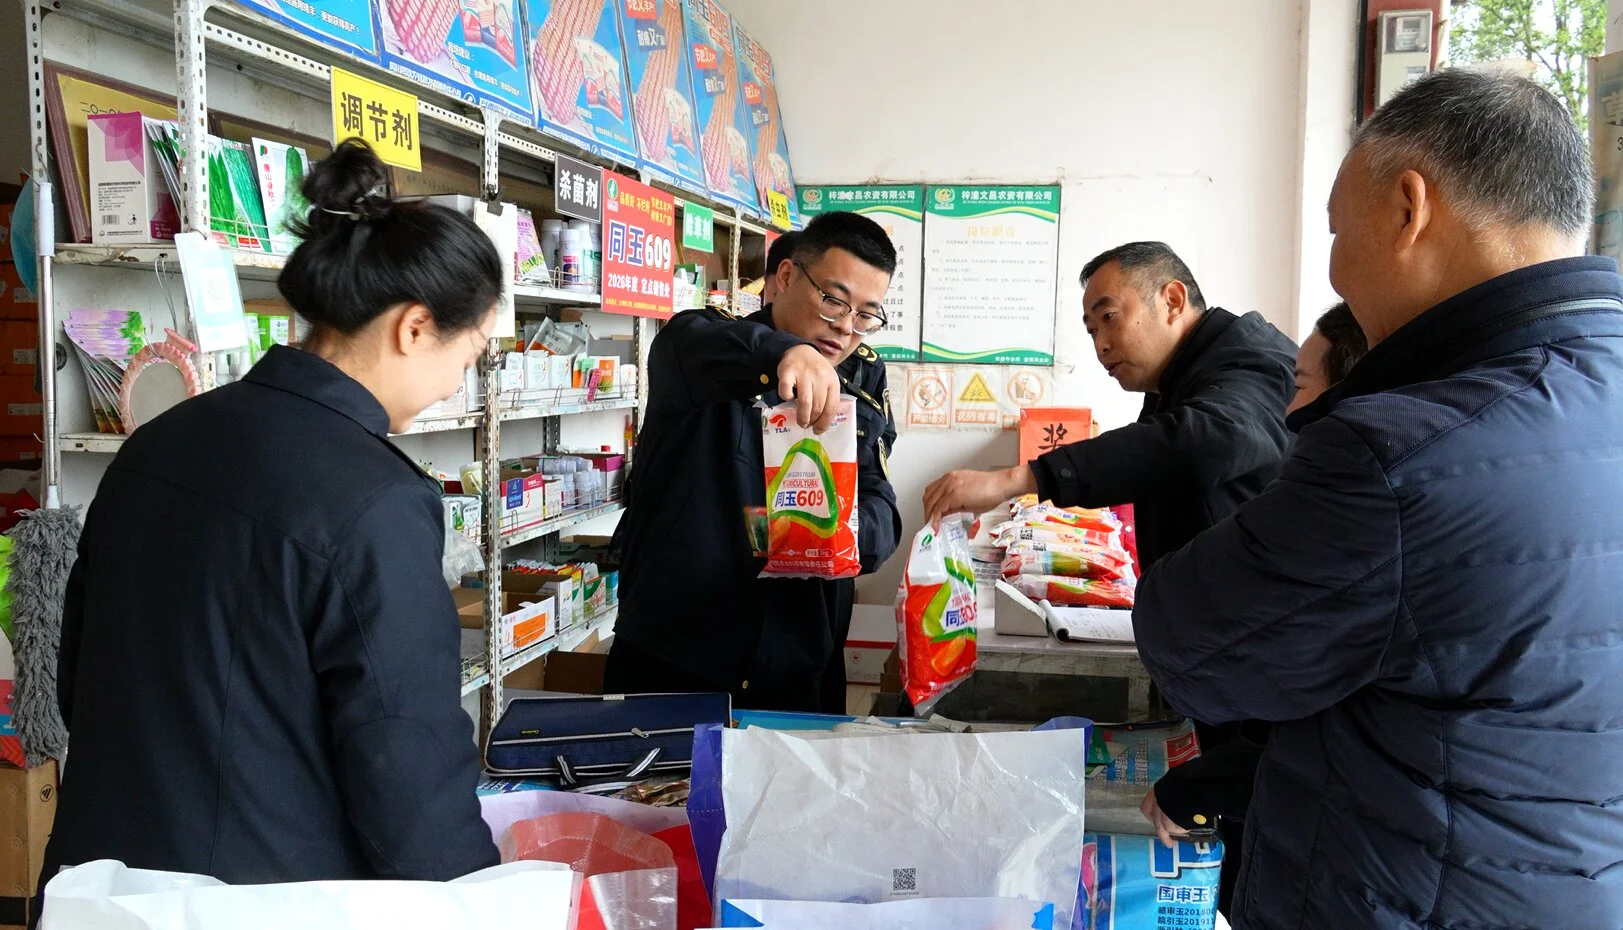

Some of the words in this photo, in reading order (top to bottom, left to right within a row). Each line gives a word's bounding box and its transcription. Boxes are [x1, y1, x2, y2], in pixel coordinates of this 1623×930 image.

[340, 91, 412, 151] 调节剂
[559, 169, 598, 210] 杀菌剂
[961, 190, 1052, 201] 梓潼文昌农资有限公司
[685, 212, 711, 241] 除草剂
[608, 218, 672, 272] 同玉609
[608, 273, 638, 292] 2026年度
[641, 277, 670, 298] 定点销售处
[775, 489, 824, 507] 同玉609
[1157, 885, 1210, 903] 国审玉
